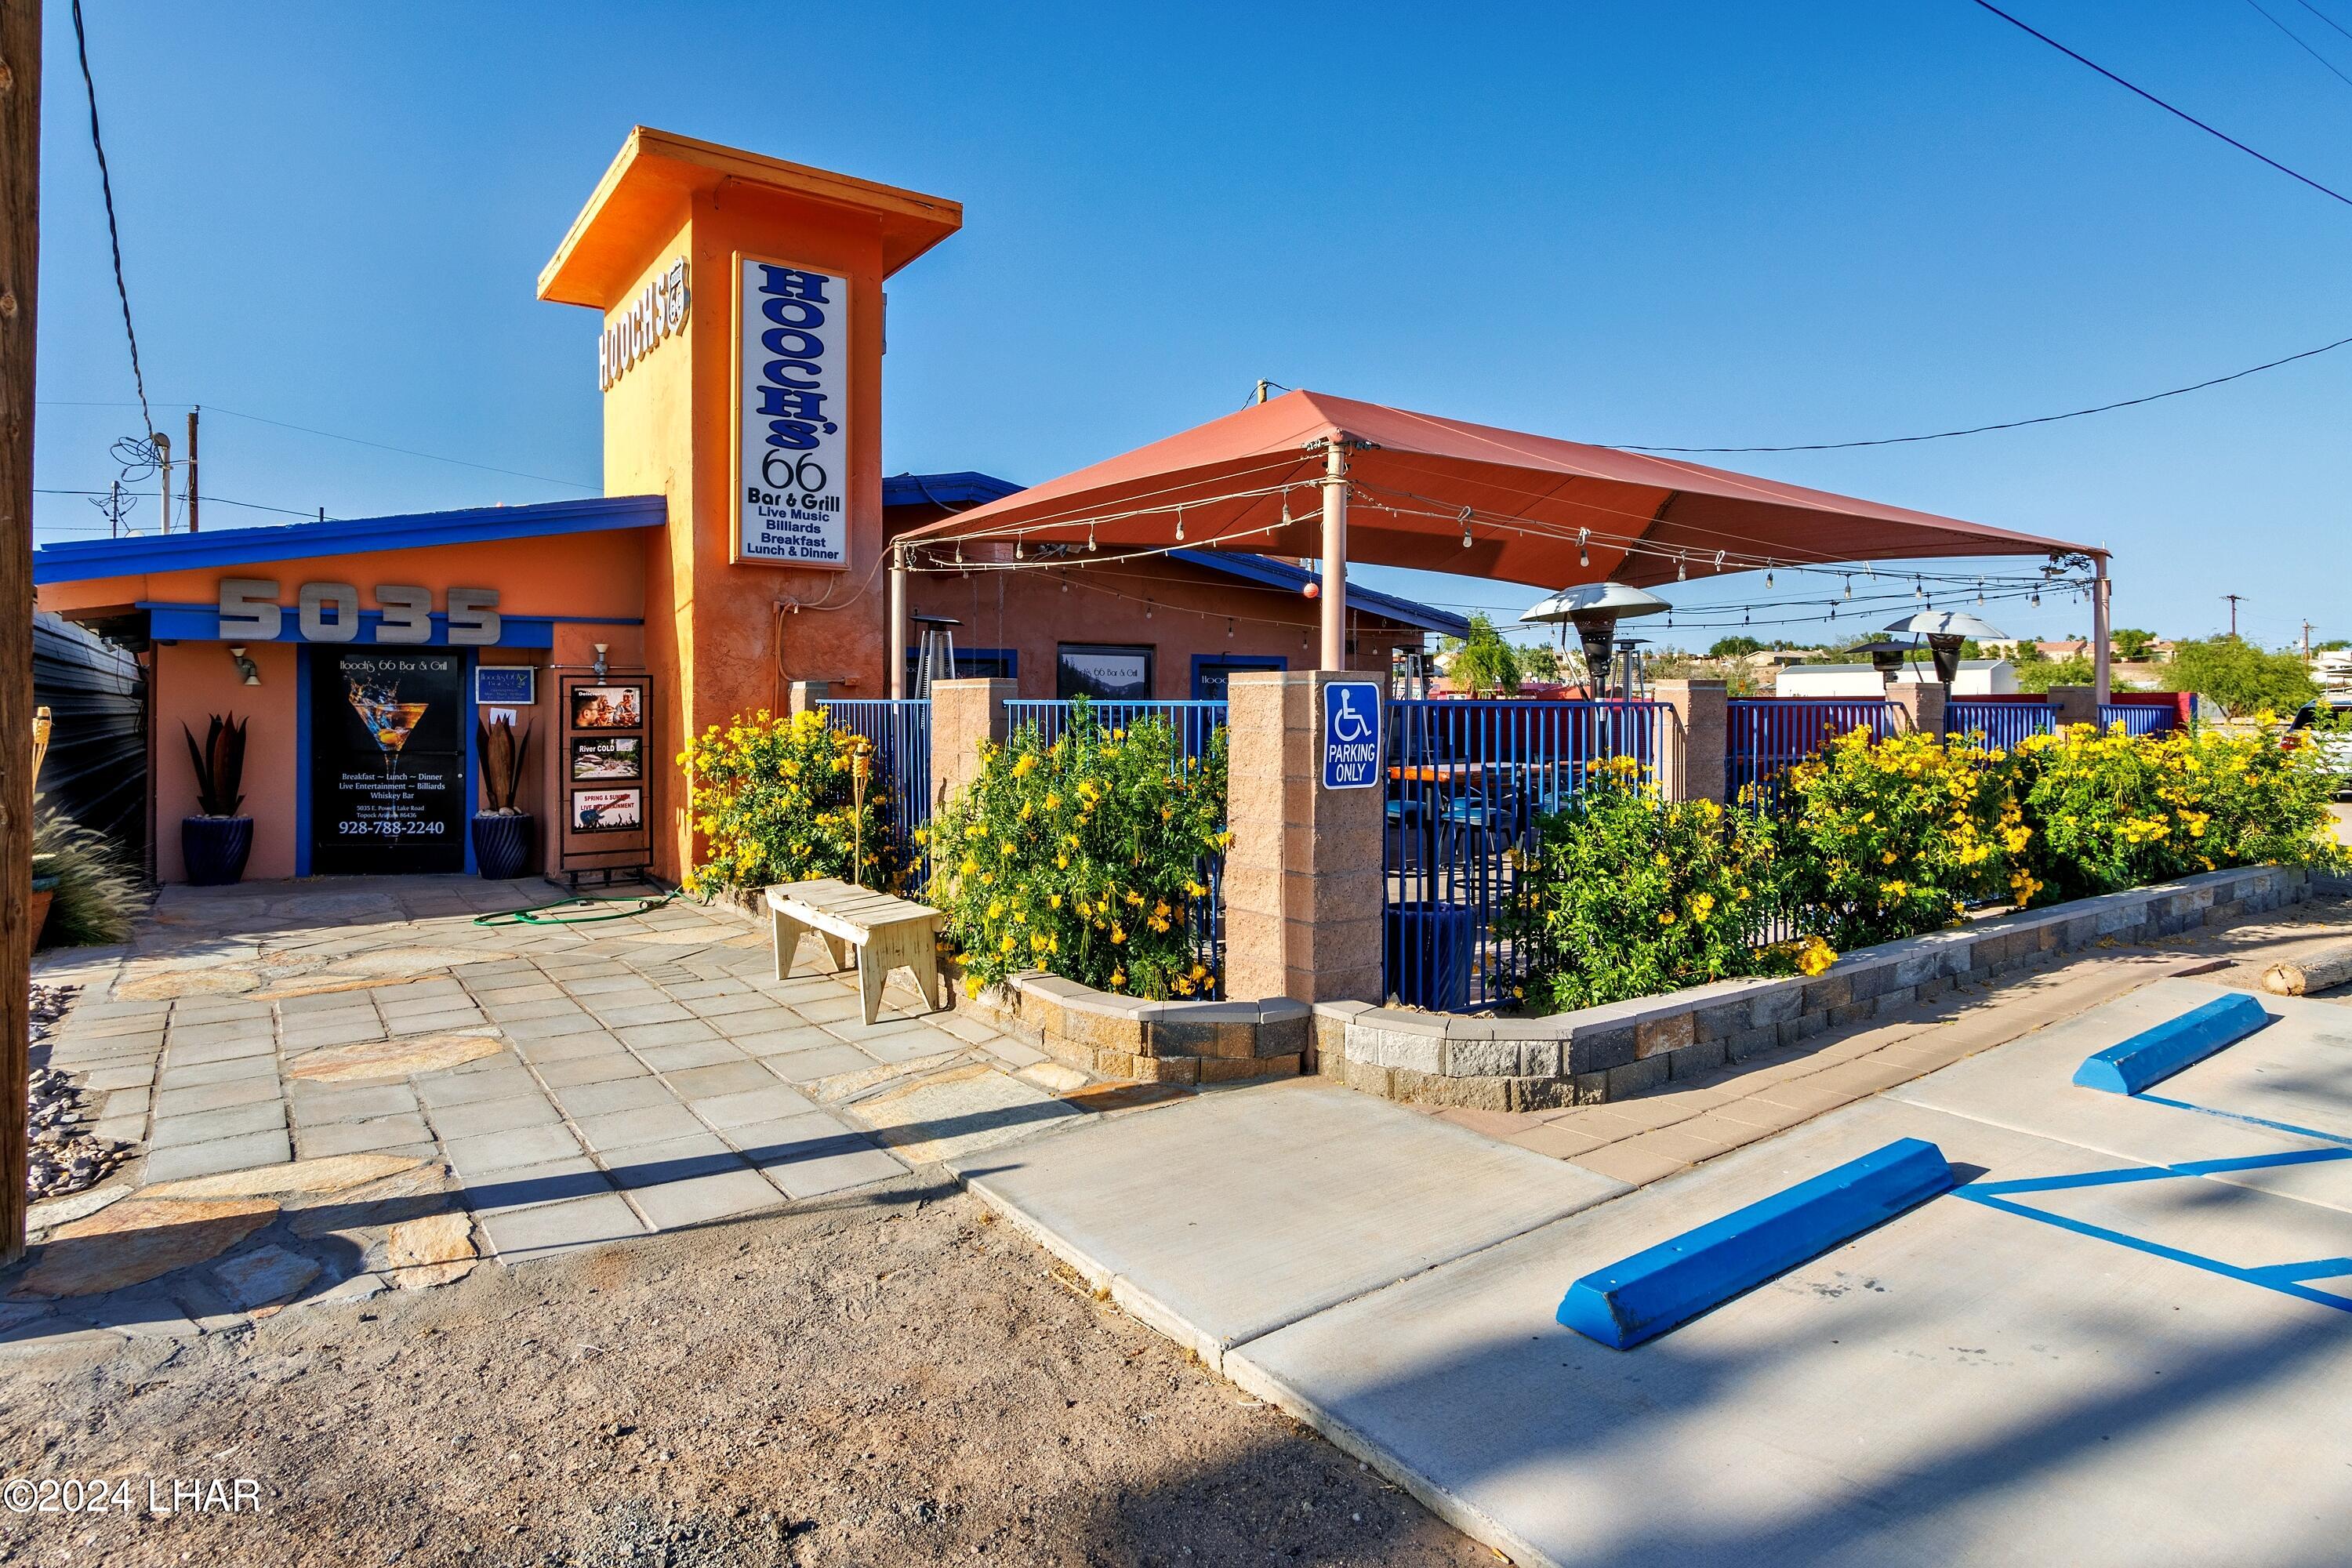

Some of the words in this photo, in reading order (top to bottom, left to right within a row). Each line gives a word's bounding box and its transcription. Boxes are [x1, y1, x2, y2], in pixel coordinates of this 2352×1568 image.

[599, 271, 666, 390] HOOCHS
[762, 448, 827, 492] 66
[748, 487, 781, 506] Bar
[786, 492, 797, 507] &
[800, 493, 840, 512] Grill
[758, 506, 786, 518] Live
[790, 509, 830, 521] Music
[766, 519, 821, 534] Billiards
[760, 532, 826, 547] Breakfast
[747, 543, 785, 555] Lunch
[788, 546, 797, 556] &
[800, 547, 839, 559] Dinner
[220, 578, 502, 646] 5035
[339, 660, 375, 673] Hooch's
[379, 660, 396, 670] 66
[400, 661, 416, 670] Bar
[419, 661, 427, 670] &
[430, 661, 447, 670] Grill
[1329, 743, 1375, 763] PARKING
[1336, 763, 1367, 782] ONLY
[370, 792, 401, 800] Whiskey
[339, 821, 445, 834] 928-788-2240
